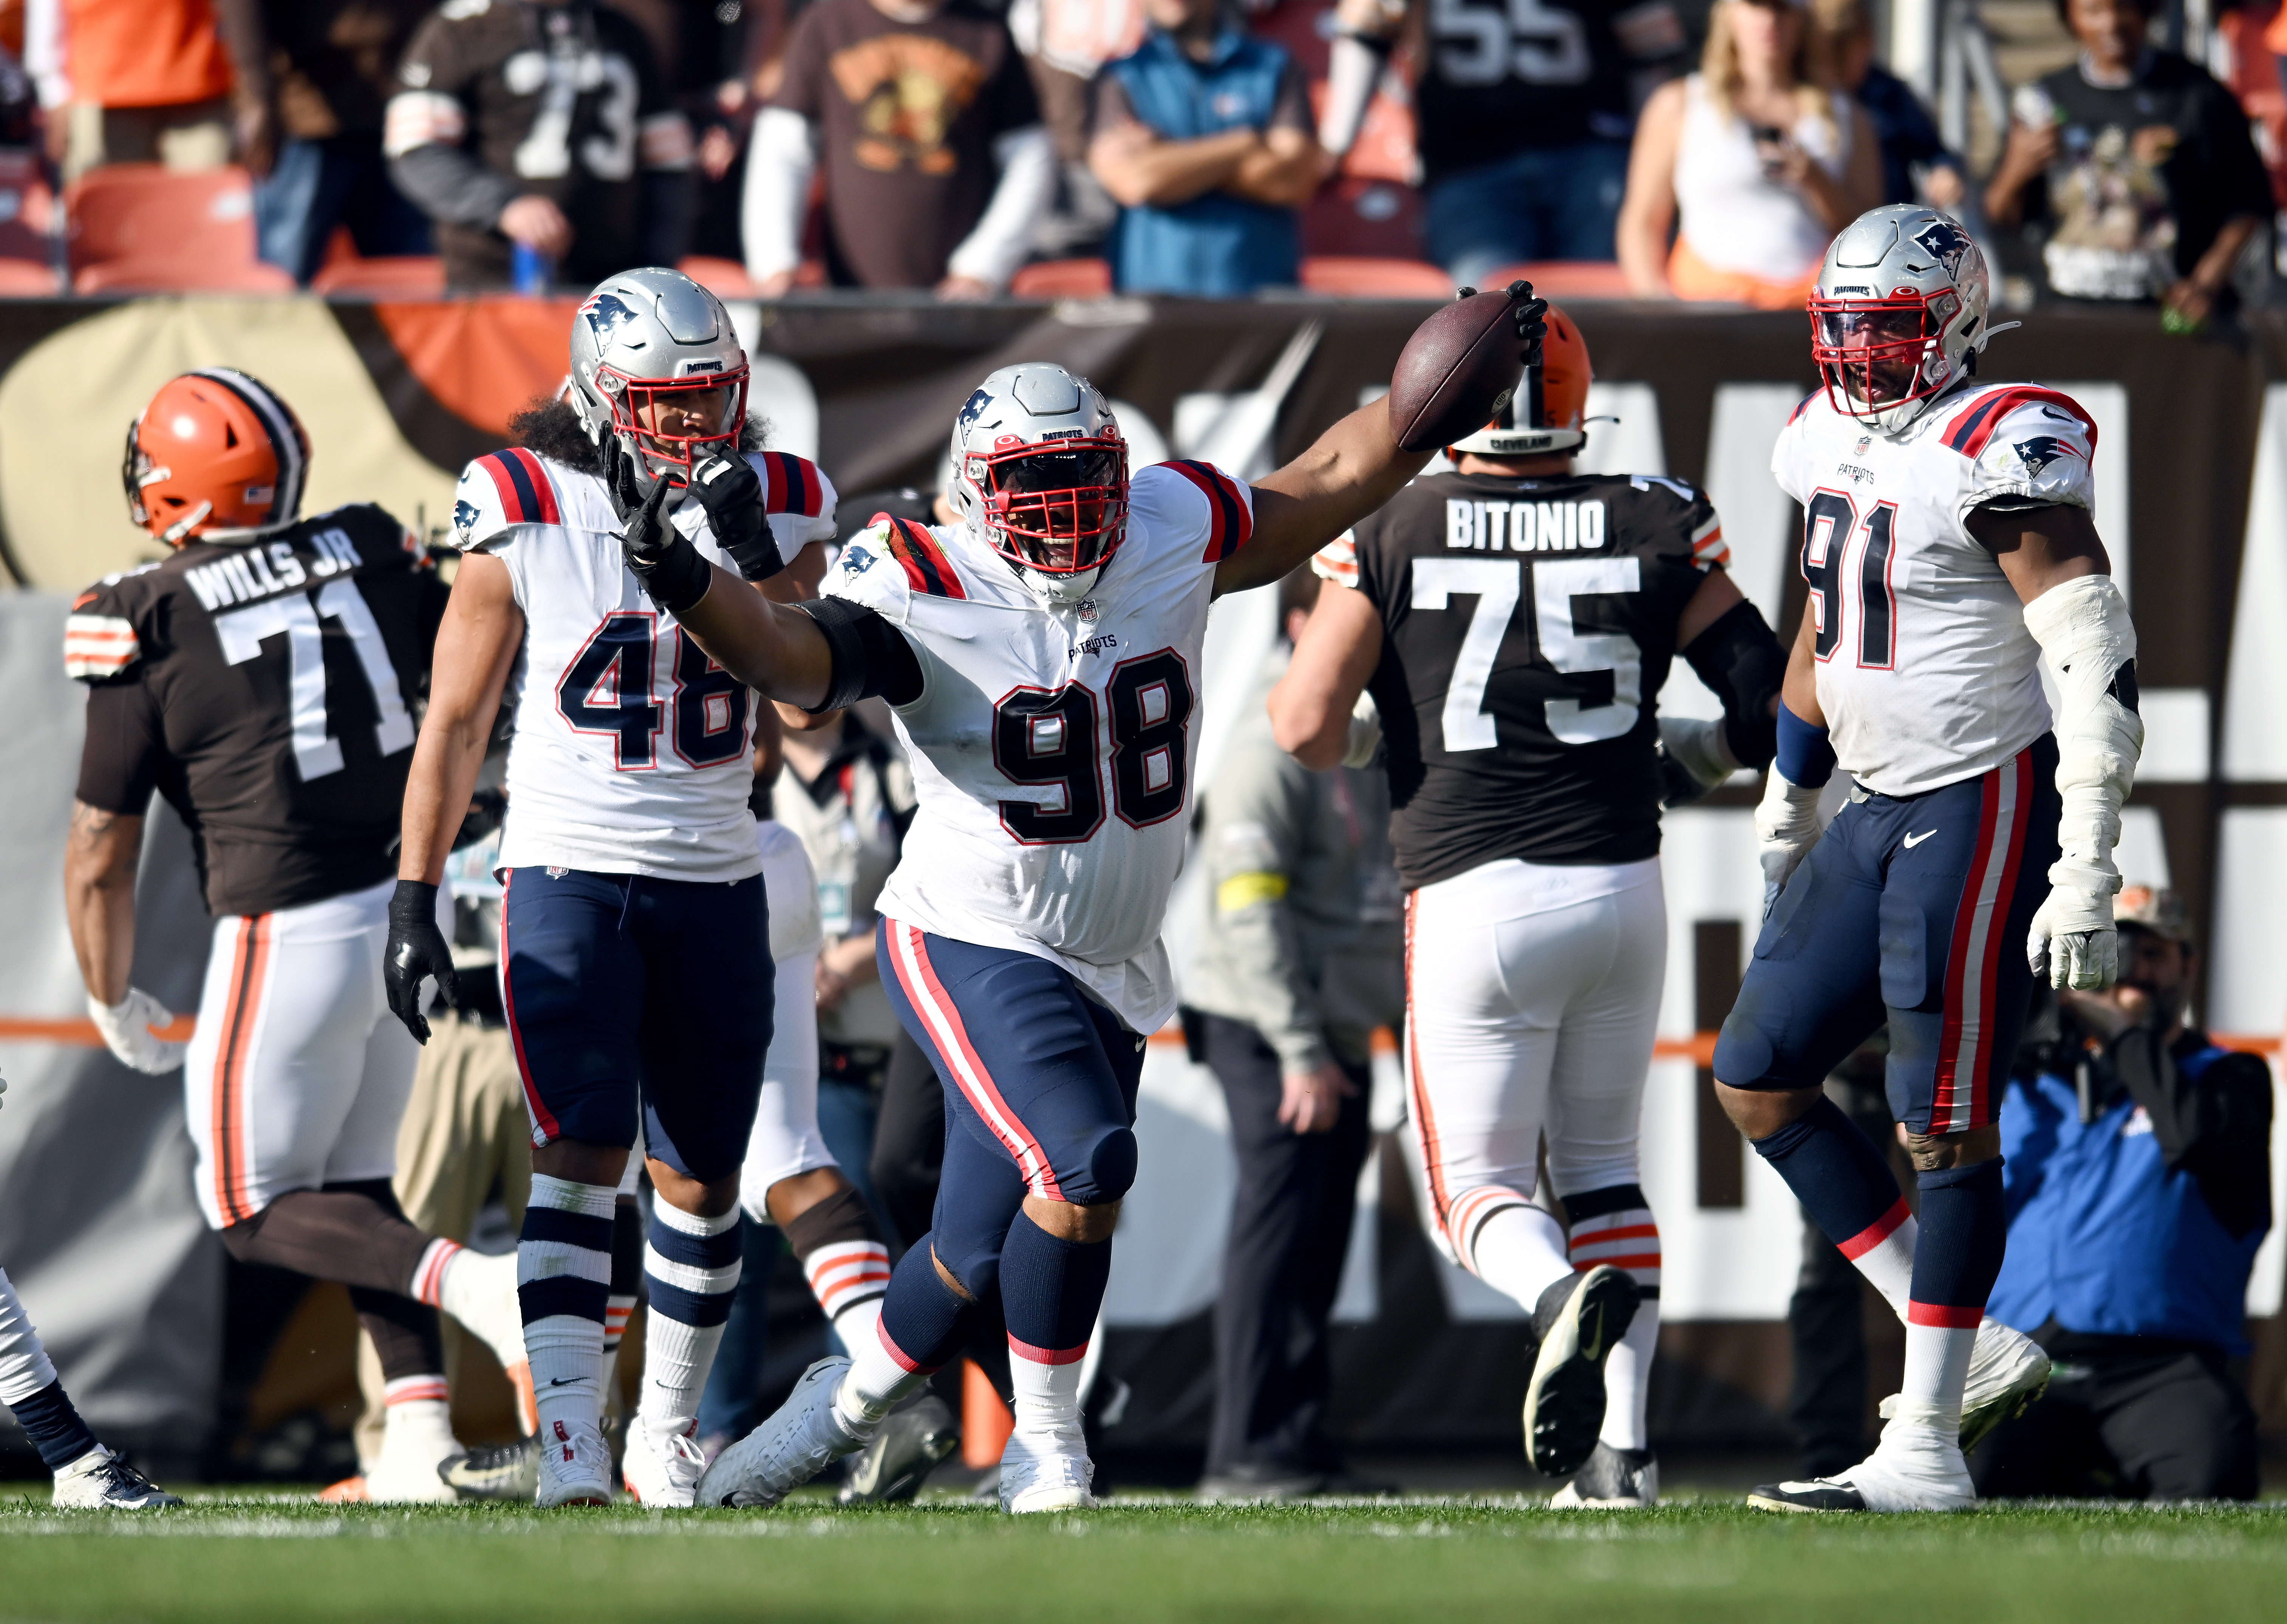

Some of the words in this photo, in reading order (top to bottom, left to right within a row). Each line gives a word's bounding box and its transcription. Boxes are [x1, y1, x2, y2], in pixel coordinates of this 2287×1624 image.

[504, 49, 640, 180] 73
[1834, 286, 1870, 296] PATRIOTS
[687, 361, 723, 374] PATRIOTS
[1042, 430, 1083, 442] PATRIOTS
[1837, 464, 1874, 485] PATRIOTS
[1446, 499, 1605, 552] BITONIO
[185, 543, 307, 612] WILLS
[311, 528, 363, 576] JR
[1801, 486, 1898, 671] 91
[1080, 609, 1096, 620] NFL
[214, 576, 416, 782] 71
[1069, 634, 1117, 664] PATRIOTS
[1412, 557, 1641, 752] 75
[555, 611, 754, 771] 48
[993, 646, 1194, 846] 98
